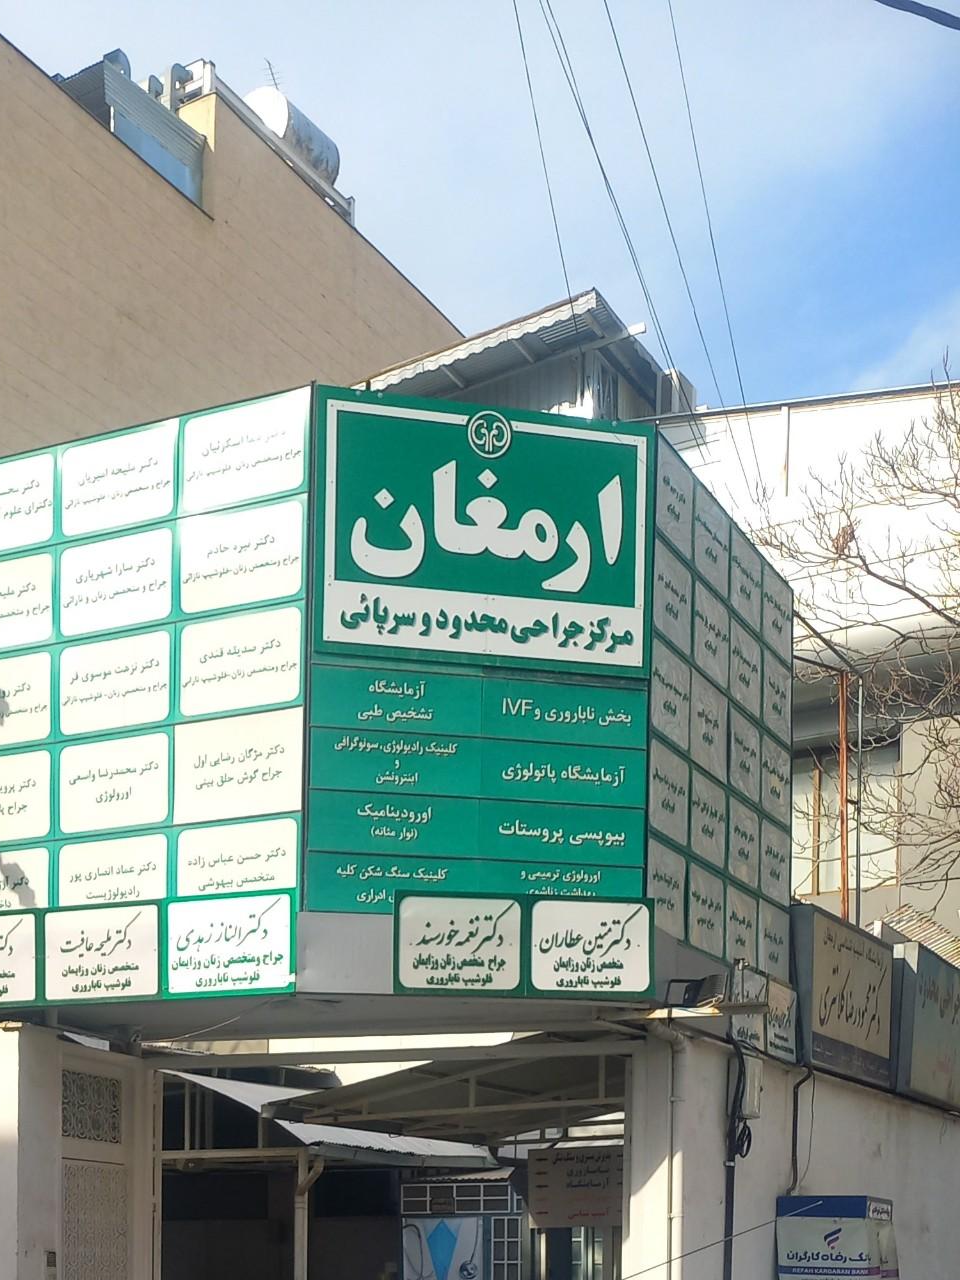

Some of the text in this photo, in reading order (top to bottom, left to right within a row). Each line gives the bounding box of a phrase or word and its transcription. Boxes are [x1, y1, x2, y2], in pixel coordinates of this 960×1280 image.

[20, 478, 40, 495] دکتر
[351, 459, 623, 593] ارمغان
[135, 556, 156, 573] دکتر
[16, 581, 36, 598] دکتر
[419, 610, 431, 636] و
[436, 608, 508, 639] محدود
[510, 612, 585, 648] جراحی
[584, 616, 634, 652] مرکز
[259, 637, 281, 655] دکتر
[139, 657, 160, 674] دکتر
[368, 680, 425, 700] آزمایشگاه
[357, 704, 433, 721] تشخیص طبی
[544, 705, 595, 723] ناباروری
[598, 708, 632, 727] بخش
[264, 743, 285, 760] دکتر
[334, 736, 379, 751] سونوگرافی
[425, 742, 458, 756] کلینیک
[237, 747, 263, 763] مژگان
[394, 758, 400, 769] و
[138, 760, 159, 776] دکتر
[502, 763, 625, 786] آزمایشگاه پاتولوژی
[17, 777, 37, 793] دکتر
[194, 766, 283, 791] جراح گوش حلق بینی
[375, 771, 418, 785] اینترونشن
[95, 785, 132, 804] اورولوژی
[6, 801, 28, 816] جراح
[357, 803, 432, 823] اورودینامیک
[498, 819, 626, 847] بیوپسی پروستات
[207, 852, 234, 868] عباس
[236, 852, 262, 865] حسن
[264, 846, 287, 862] دکتر
[136, 860, 157, 876] دکتر
[336, 865, 448, 883] کلینیک سنگ شکن کلیه
[527, 869, 560, 881] ترمیمی
[562, 870, 601, 883] اورولوژی
[197, 872, 275, 892] متخصص بیهوشی
[85, 884, 140, 901] رادیولوژیست
[356, 888, 385, 903] ادراری
[237, 896, 282, 947] دکتر
[471, 901, 516, 955] دکتر
[107, 911, 142, 956] دکتر
[599, 905, 643, 958] دکتر
[203, 954, 221, 969] زنان
[263, 950, 284, 967] جراح
[440, 955, 456, 971] زنان
[457, 955, 485, 970] متخصص
[487, 955, 506, 971] جراح
[580, 957, 596, 973] زنان
[596, 958, 624, 971] متخصص
[90, 963, 107, 976] زنان
[107, 961, 139, 974] متخصص
[71, 976, 132, 993] فلوشیپ ناباروری
[195, 970, 260, 988] فلوشیپ ناباروری
[426, 972, 493, 987] فلوشیپ ناباروری
[556, 975, 622, 989] فلوشیپ ناباروری
